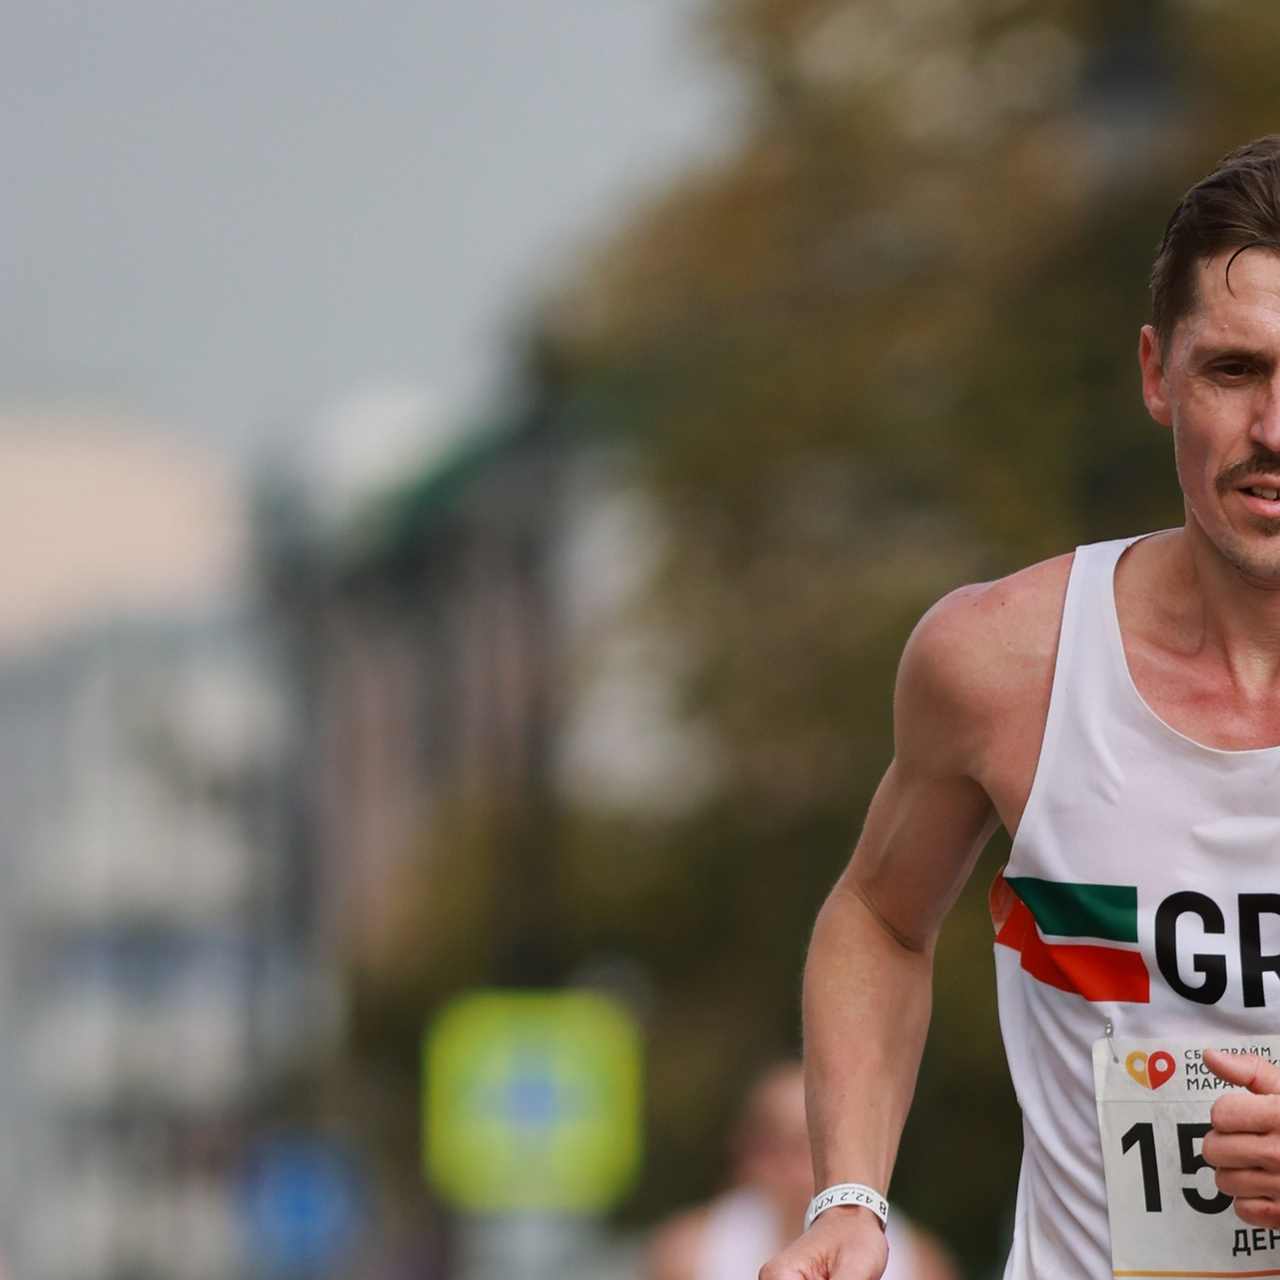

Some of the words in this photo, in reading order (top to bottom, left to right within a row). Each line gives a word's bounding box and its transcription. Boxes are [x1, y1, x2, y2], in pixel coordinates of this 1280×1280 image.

[1184, 1045, 1271, 1060] СБПРАЙМ
[1186, 1078, 1235, 1091] МАРА
[840, 1190, 874, 1204] 42,2
